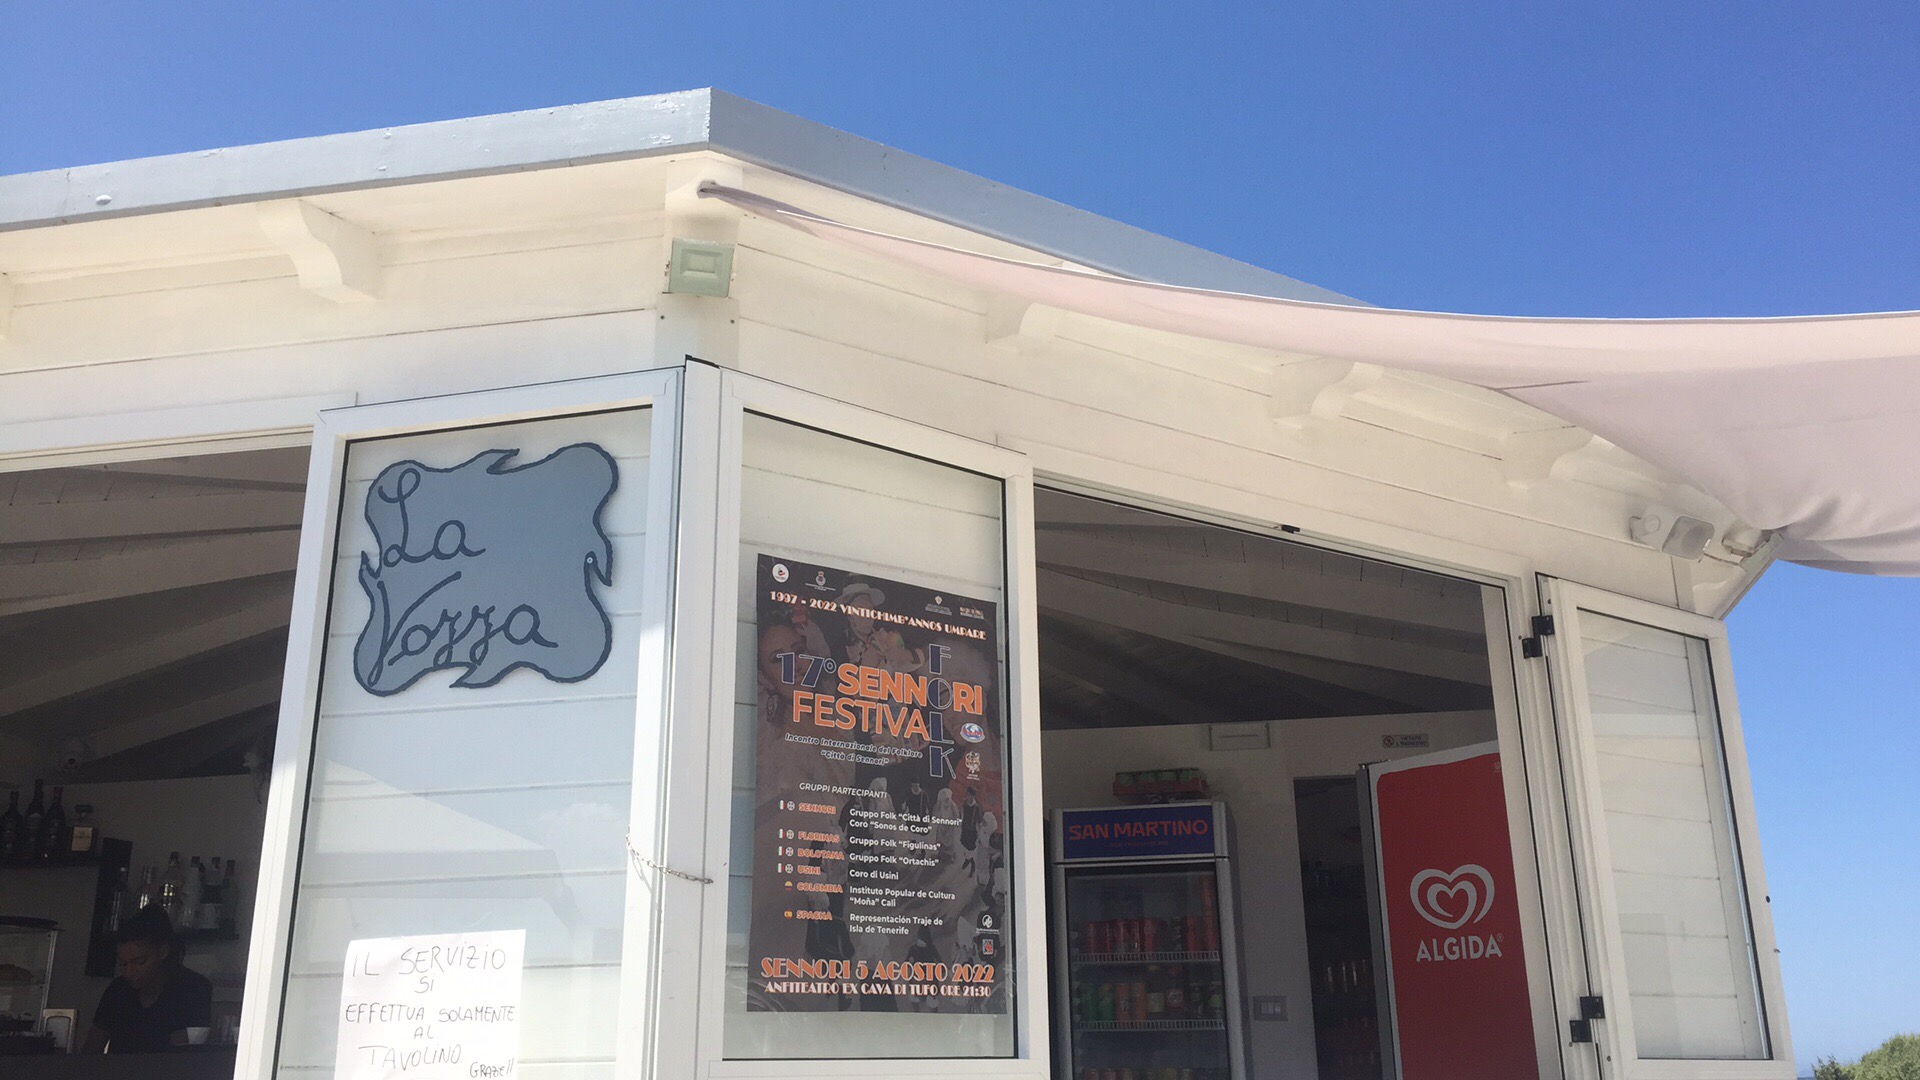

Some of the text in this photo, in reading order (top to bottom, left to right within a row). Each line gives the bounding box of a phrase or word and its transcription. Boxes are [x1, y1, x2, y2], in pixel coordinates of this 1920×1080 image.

[378, 467, 486, 567] La
[770, 590, 798, 604] 1997
[809, 598, 837, 612] 2022
[944, 624, 987, 641] UMPARE
[367, 570, 559, 687] Vozza
[785, 733, 923, 759] Incontro Internazionale del Folklore
[846, 753, 855, 761] di
[799, 782, 888, 799] GRUPPI PARTECIPANTI
[798, 802, 836, 815] SENNORI
[849, 808, 879, 819] Gruppo
[880, 811, 897, 820] Folk
[849, 819, 869, 828] Coro
[1068, 819, 1209, 841] SAN MARTINO
[797, 830, 840, 843] FLORINAS
[849, 836, 879, 847] Gruppo
[880, 839, 897, 847] Folk
[849, 853, 879, 864] Gruppo
[880, 855, 897, 864] Folk
[797, 864, 821, 875] USINI
[849, 869, 899, 880] Coro di Usini
[796, 881, 843, 893] COLOMBIA
[849, 885, 956, 900] Instituto Popular de Cultura
[881, 898, 896, 907] Cali
[796, 909, 833, 921] SPAGNA
[849, 913, 944, 927] Representación Traje de
[849, 924, 910, 935] Isla de Tenerife
[1416, 933, 1503, 963] ALGIDA
[352, 951, 380, 977] IL
[760, 957, 995, 983] SENNORI 5 AGOSTO 2022
[764, 981, 992, 998] ANFITEATRO EX CAVA DI TUFO ORE 21:30
[345, 1002, 515, 1024] EFFETTUA SOLAMENTE
[413, 1025, 434, 1040] AL
